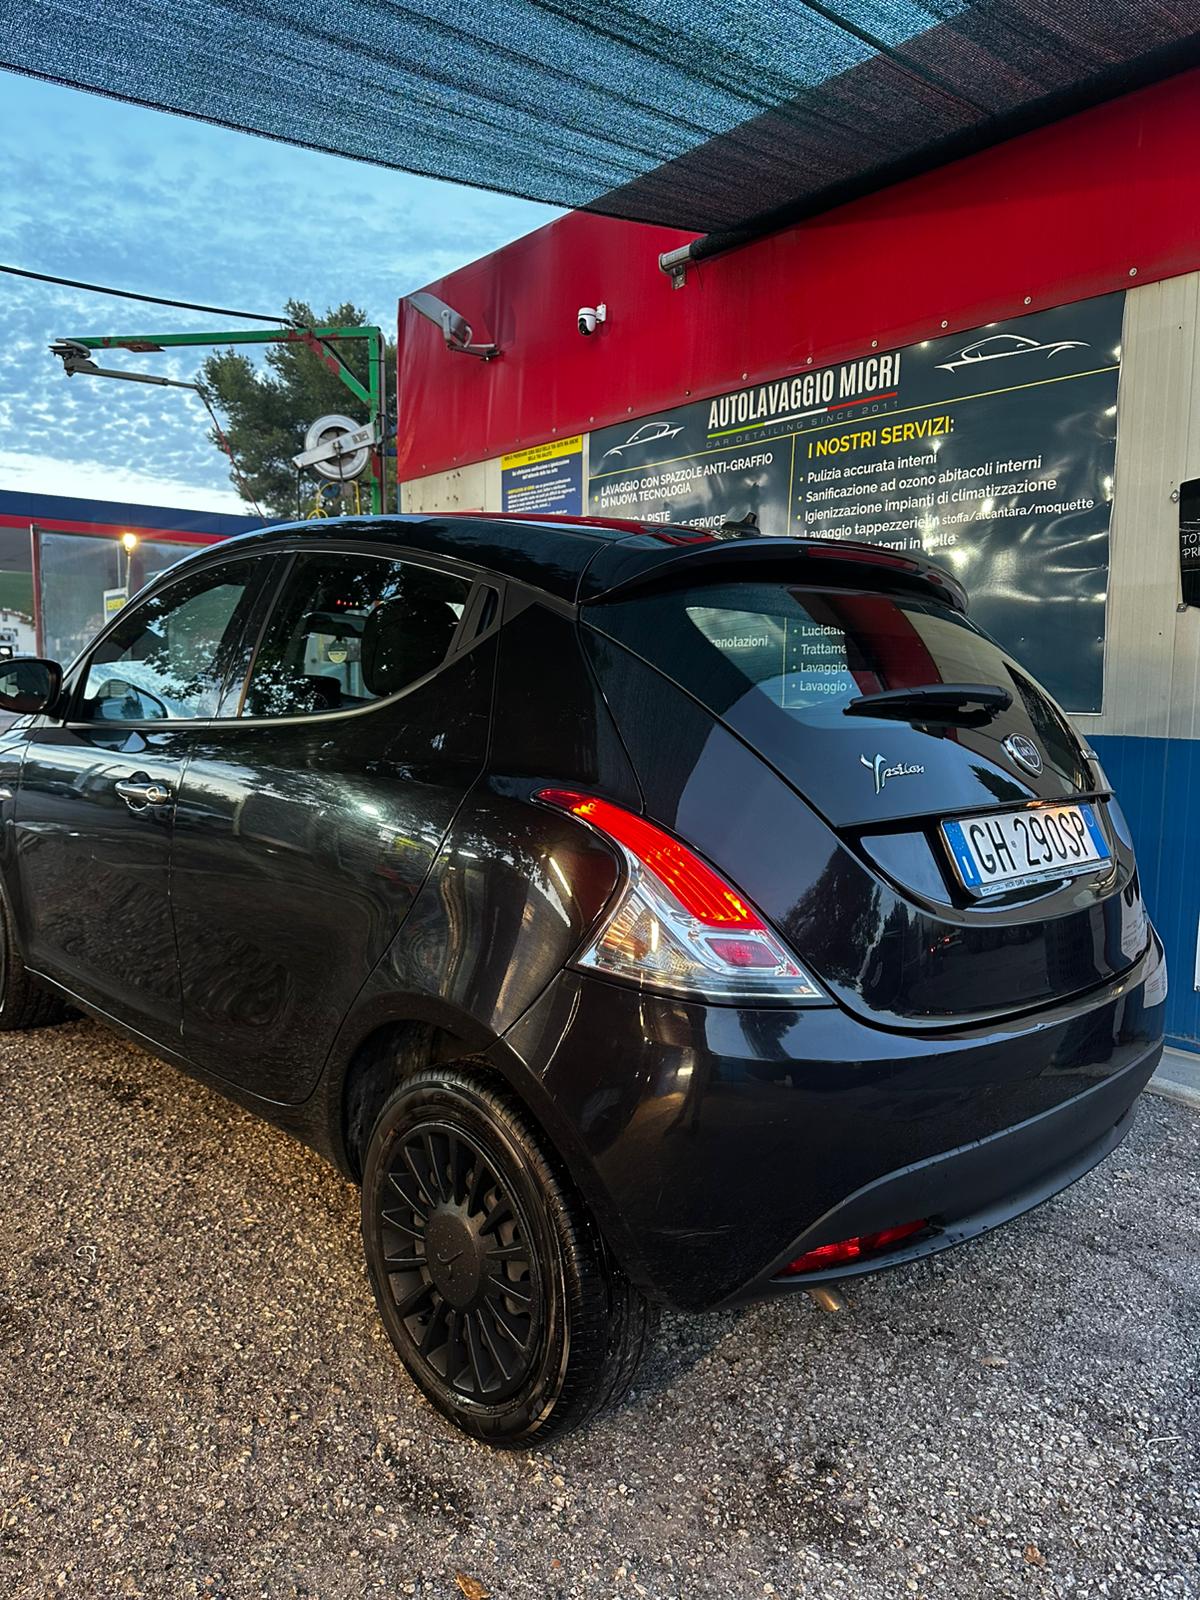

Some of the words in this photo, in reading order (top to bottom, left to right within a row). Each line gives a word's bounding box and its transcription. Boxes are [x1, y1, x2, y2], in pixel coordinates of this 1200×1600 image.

[707, 369, 834, 430] AUTOLAVAGGIO
[838, 352, 901, 399] MICRI
[705, 438, 729, 449] CAR
[735, 421, 804, 443] DETAILING
[811, 409, 853, 427] SINCE
[862, 400, 899, 415] 2011
[808, 443, 813, 459] I
[816, 429, 877, 457] NOSTRI
[880, 415, 955, 441] SERVIZI:
[601, 477, 640, 497] LAVAGGIO
[640, 474, 660, 489] CON
[660, 466, 703, 485] SPAZZOLE
[703, 452, 774, 476] ANTI-GRAFFIO
[806, 483, 882, 503] Sanificazione
[880, 478, 896, 492] ad
[898, 474, 936, 490] ozono
[938, 461, 993, 484] abitacoli
[995, 454, 1042, 474] interni
[807, 468, 842, 484] Pulizia
[843, 459, 895, 478] accurata
[897, 453, 937, 469] interni
[601, 497, 609, 508] DI
[610, 493, 638, 507] NUOVA
[638, 482, 692, 503] TECNOLOGIA
[804, 502, 883, 524] Igienizzazione
[884, 493, 935, 512] impianti
[937, 490, 949, 504] di
[951, 478, 1058, 503] climatizzazione
[647, 511, 671, 523] PISTE
[689, 514, 727, 528] SERVICE
[804, 524, 852, 541] Lavaggio
[854, 516, 925, 537] tappezzerie
[868, 537, 907, 551] terni
[909, 537, 921, 549] in
[1181, 532, 1200, 545] TO
[800, 662, 848, 676] Lavaggio
[800, 680, 847, 695] Lavaggio
[860, 753, 925, 795] Ypsilon
[969, 820, 1017, 875] GH
[1013, 811, 1089, 866] 290SP
